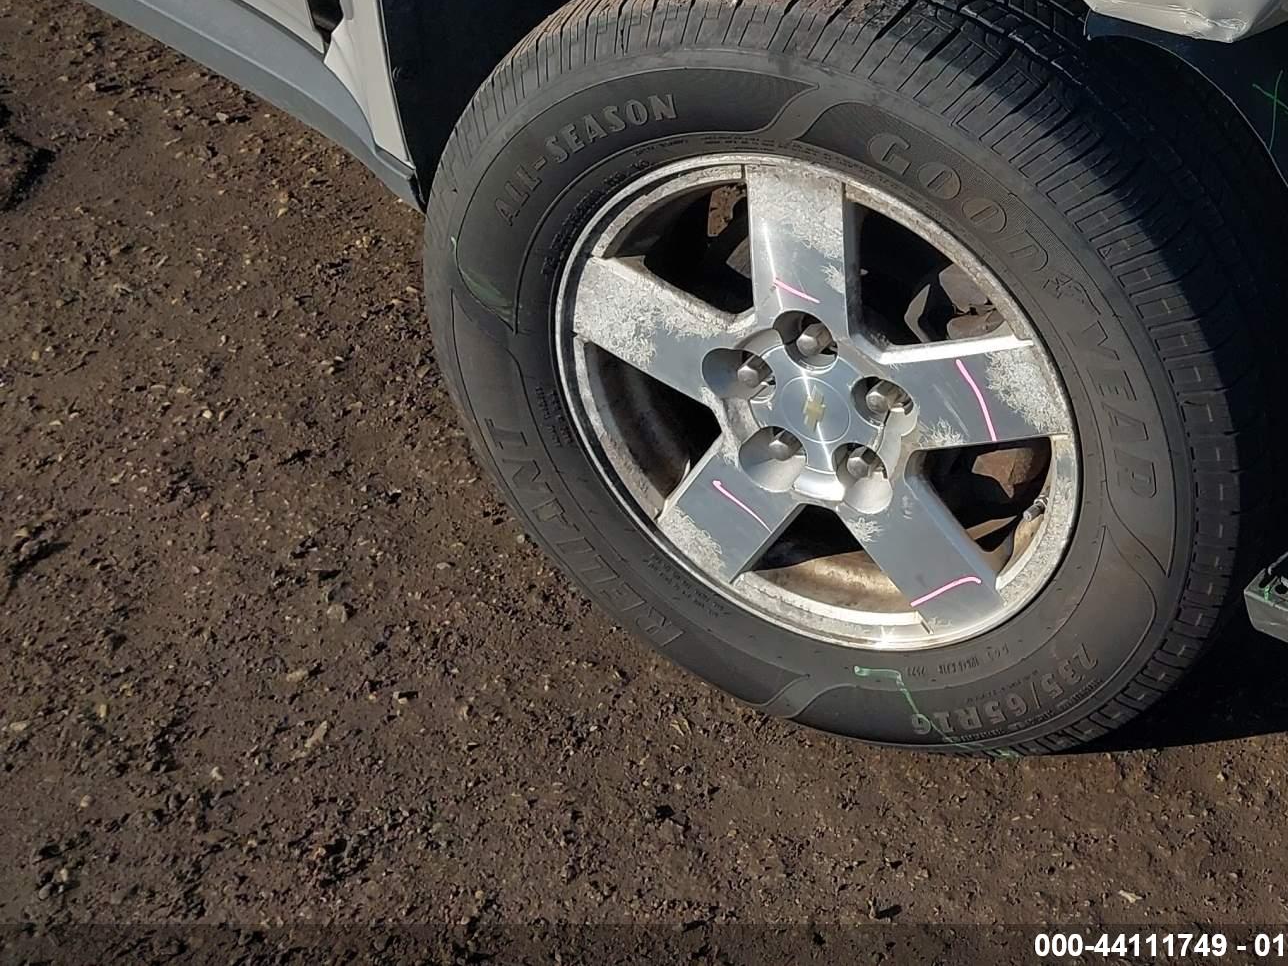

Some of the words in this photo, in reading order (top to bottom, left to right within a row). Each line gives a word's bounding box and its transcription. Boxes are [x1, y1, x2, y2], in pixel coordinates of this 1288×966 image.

[495, 94, 678, 227] ALL-SEASON
[484, 418, 685, 647] RELIANT
[911, 643, 1099, 735] 235/65R16
